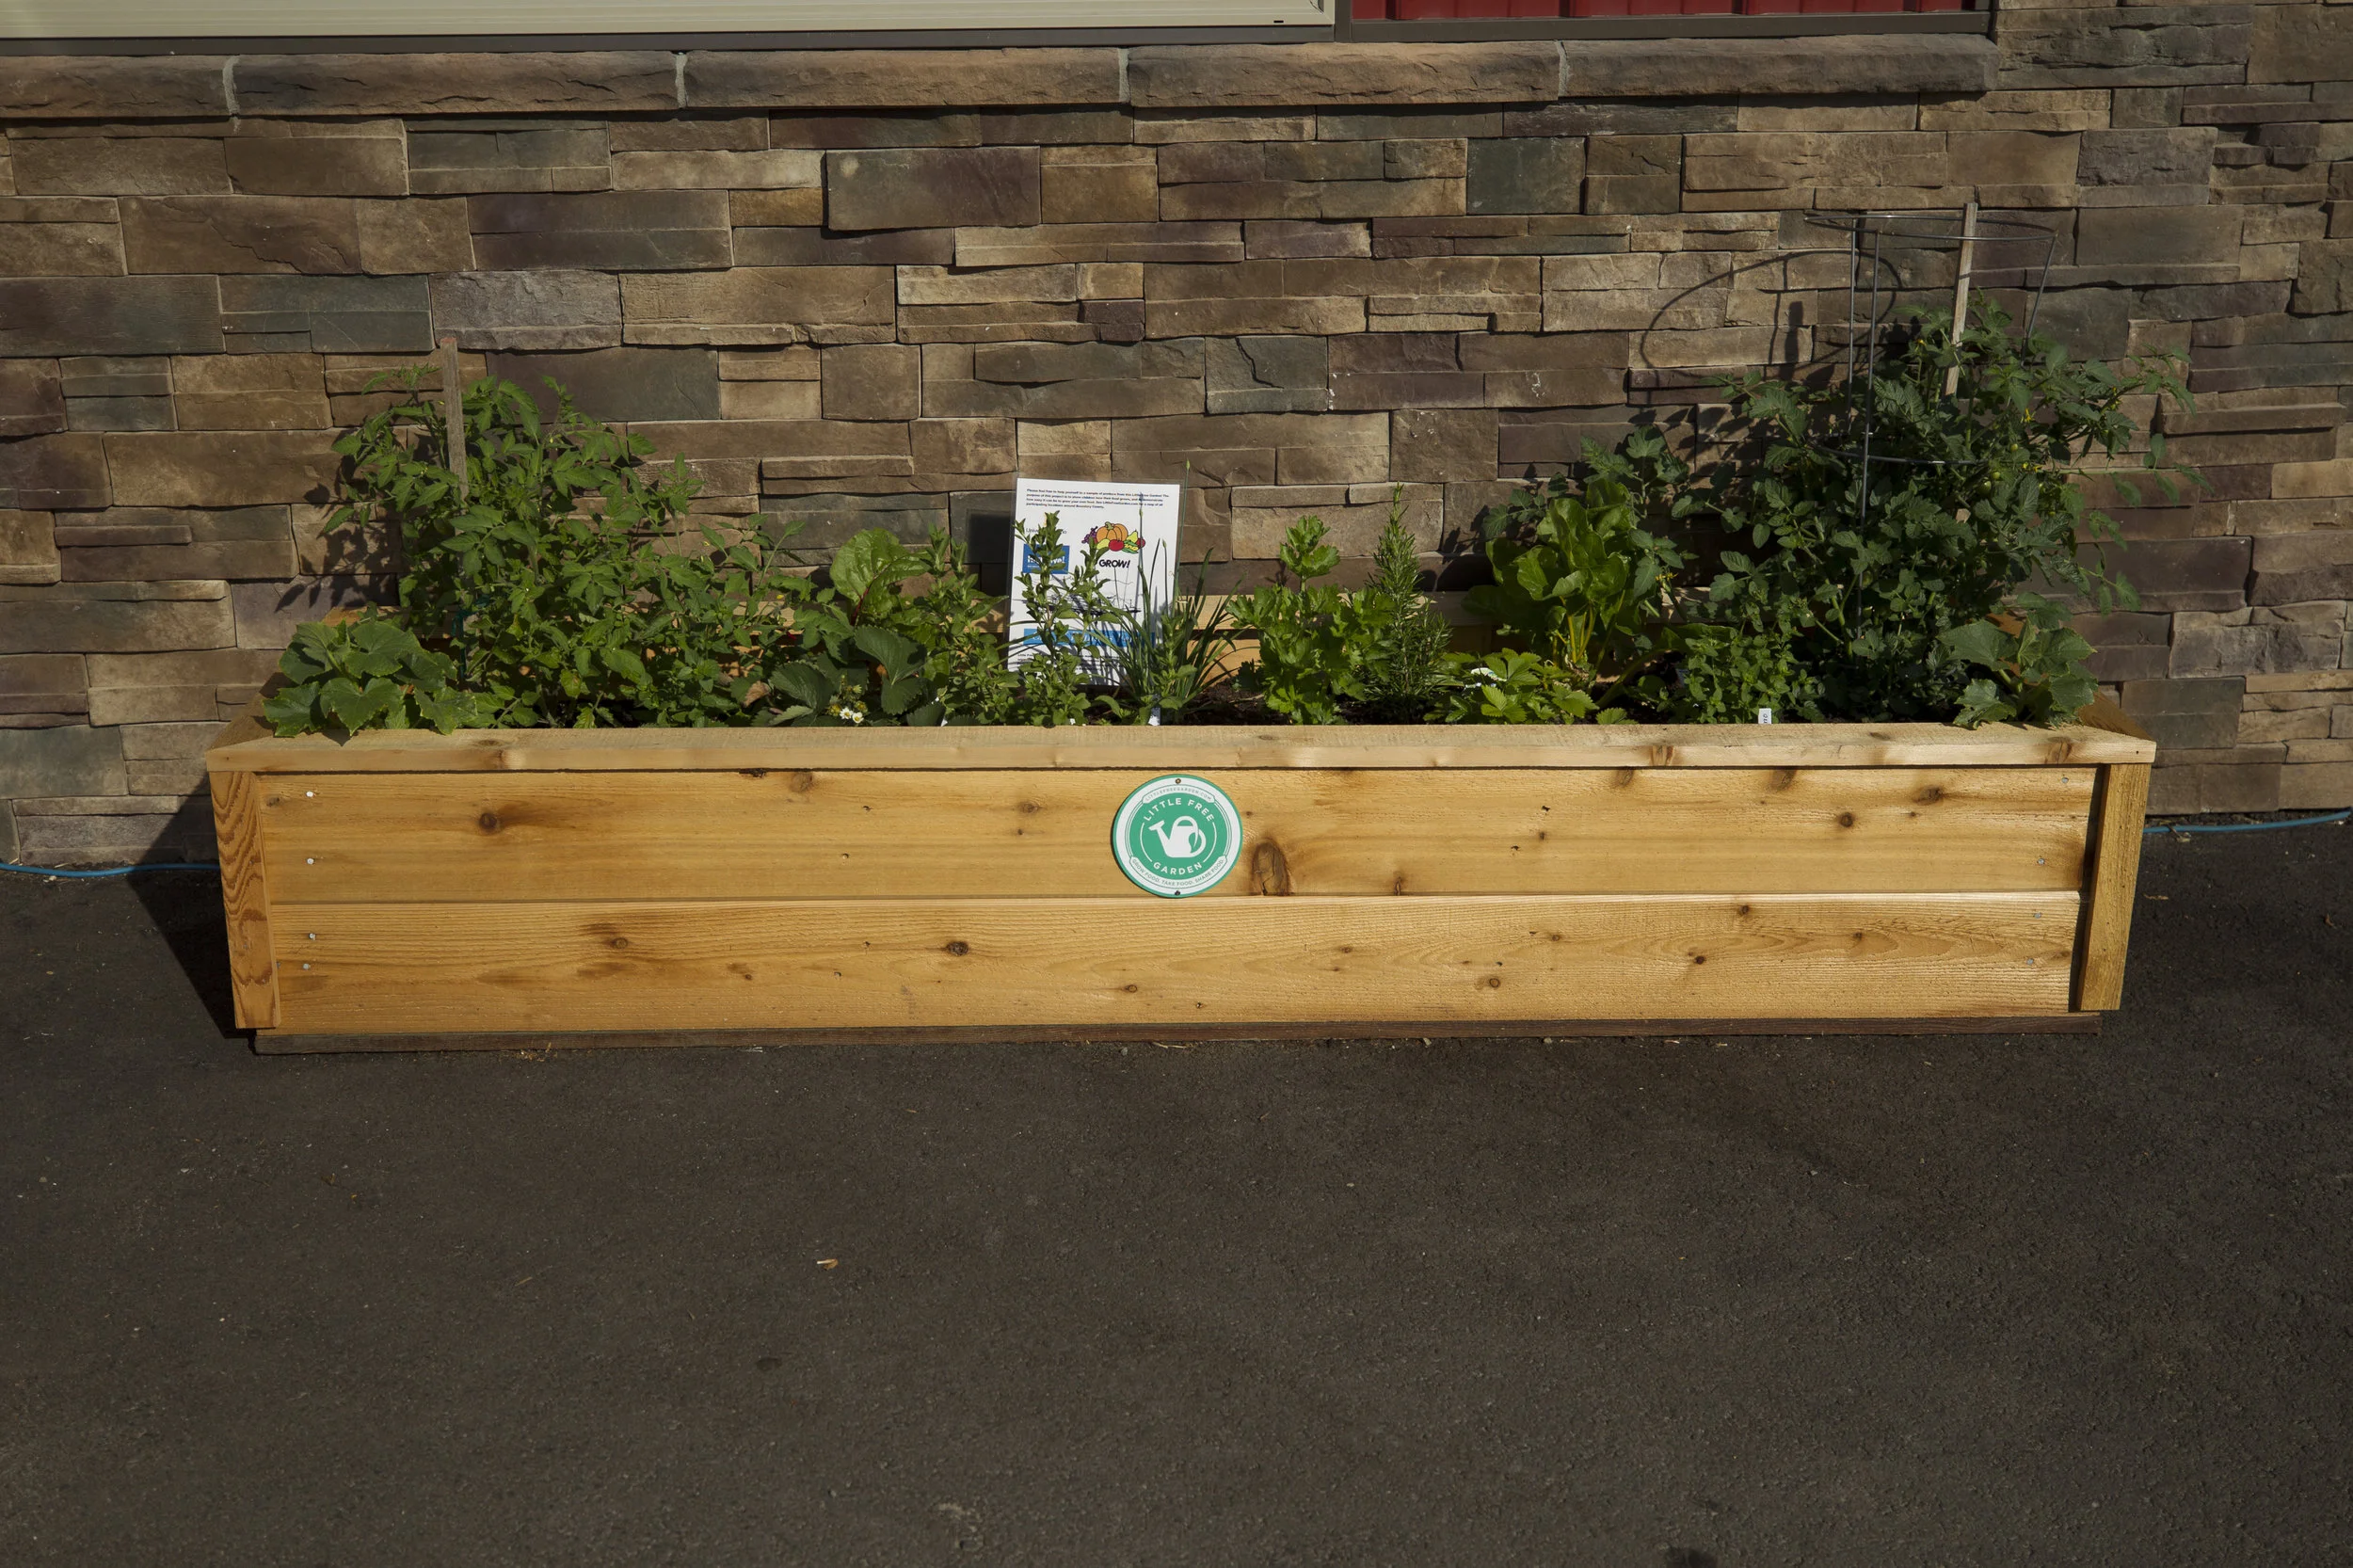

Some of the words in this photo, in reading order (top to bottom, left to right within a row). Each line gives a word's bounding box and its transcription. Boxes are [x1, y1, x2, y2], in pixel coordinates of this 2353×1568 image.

[1098, 559, 1130, 568] GROW!
[1144, 797, 1182, 822] LITTLE
[1187, 799, 1215, 822] FREE
[1132, 858, 1145, 873] GROW
[1195, 872, 1211, 883] SHARE
[1153, 861, 1203, 875] GARDEN
